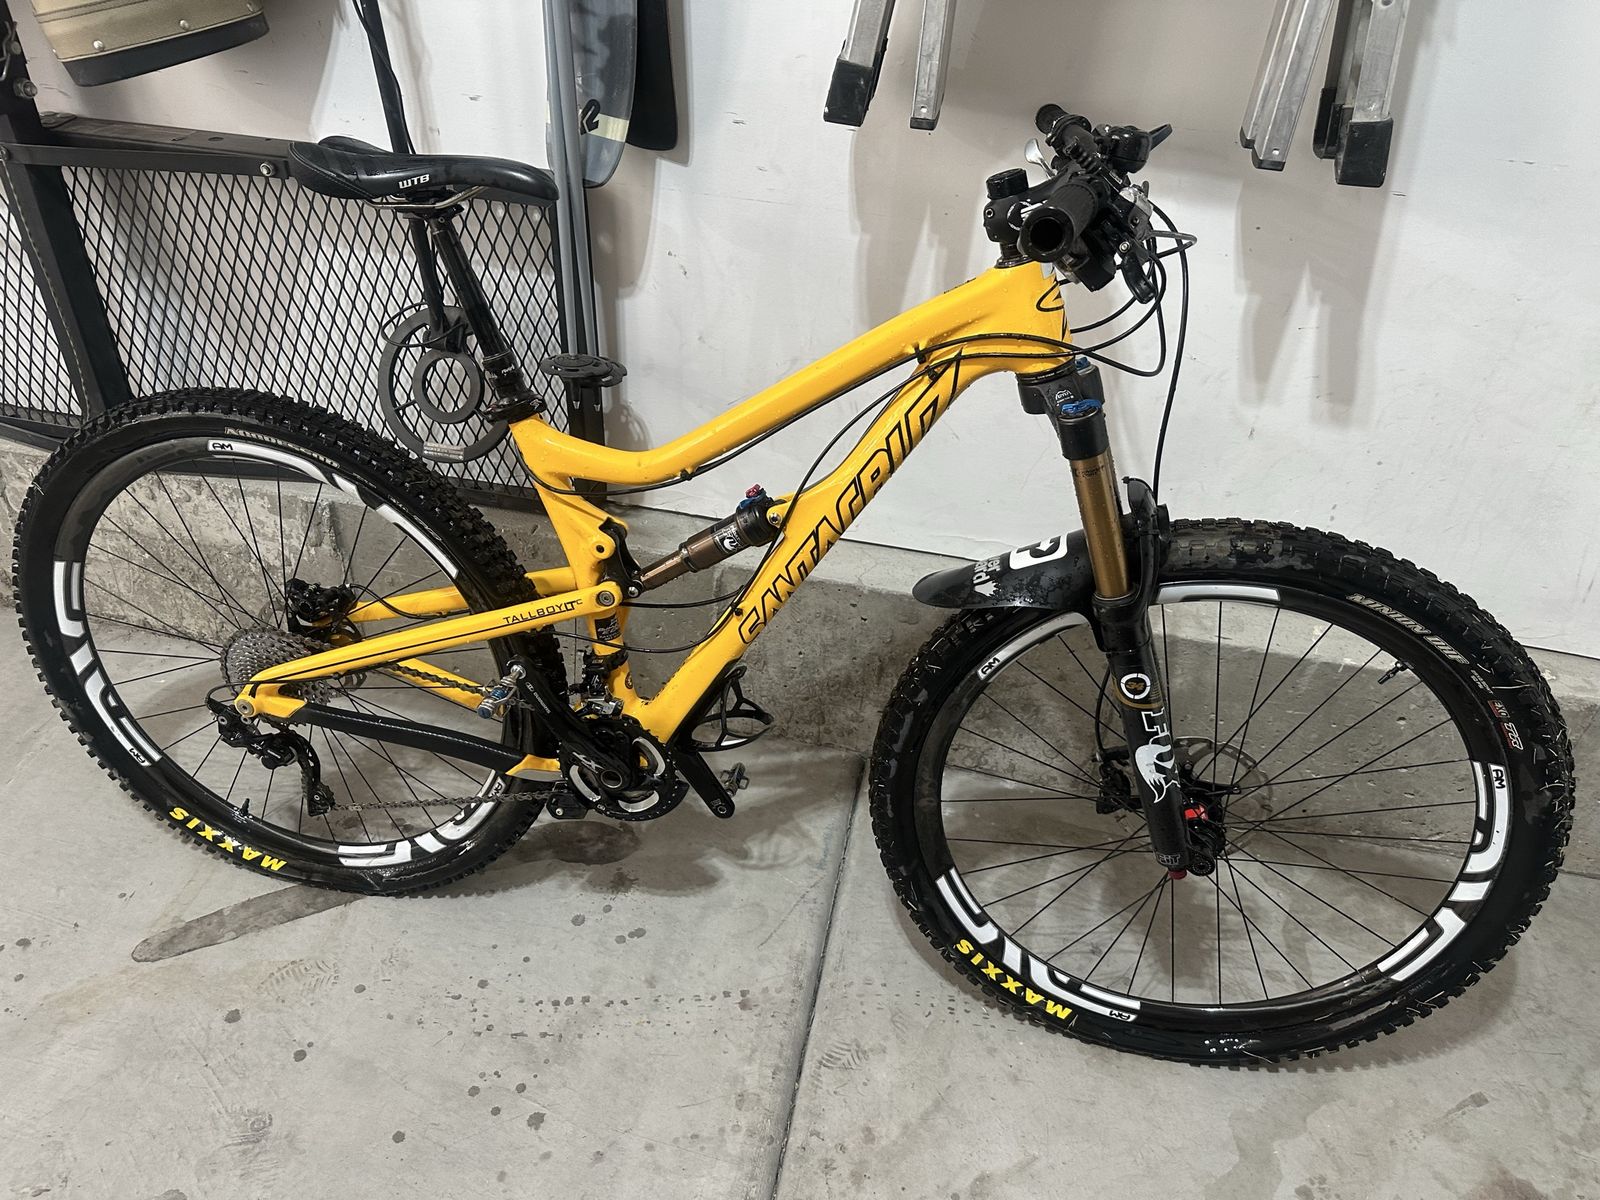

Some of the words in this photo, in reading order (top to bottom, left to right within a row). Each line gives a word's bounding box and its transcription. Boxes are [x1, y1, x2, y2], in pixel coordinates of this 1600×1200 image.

[398, 173, 430, 189] WTB
[211, 442, 234, 451] AM
[1345, 593, 1432, 635] MINION
[981, 657, 1001, 674] AM
[1492, 768, 1506, 789] AM
[168, 807, 288, 871] MAXXIS
[955, 938, 1073, 1020] MAXXIS
[1108, 1009, 1131, 1021] AM
